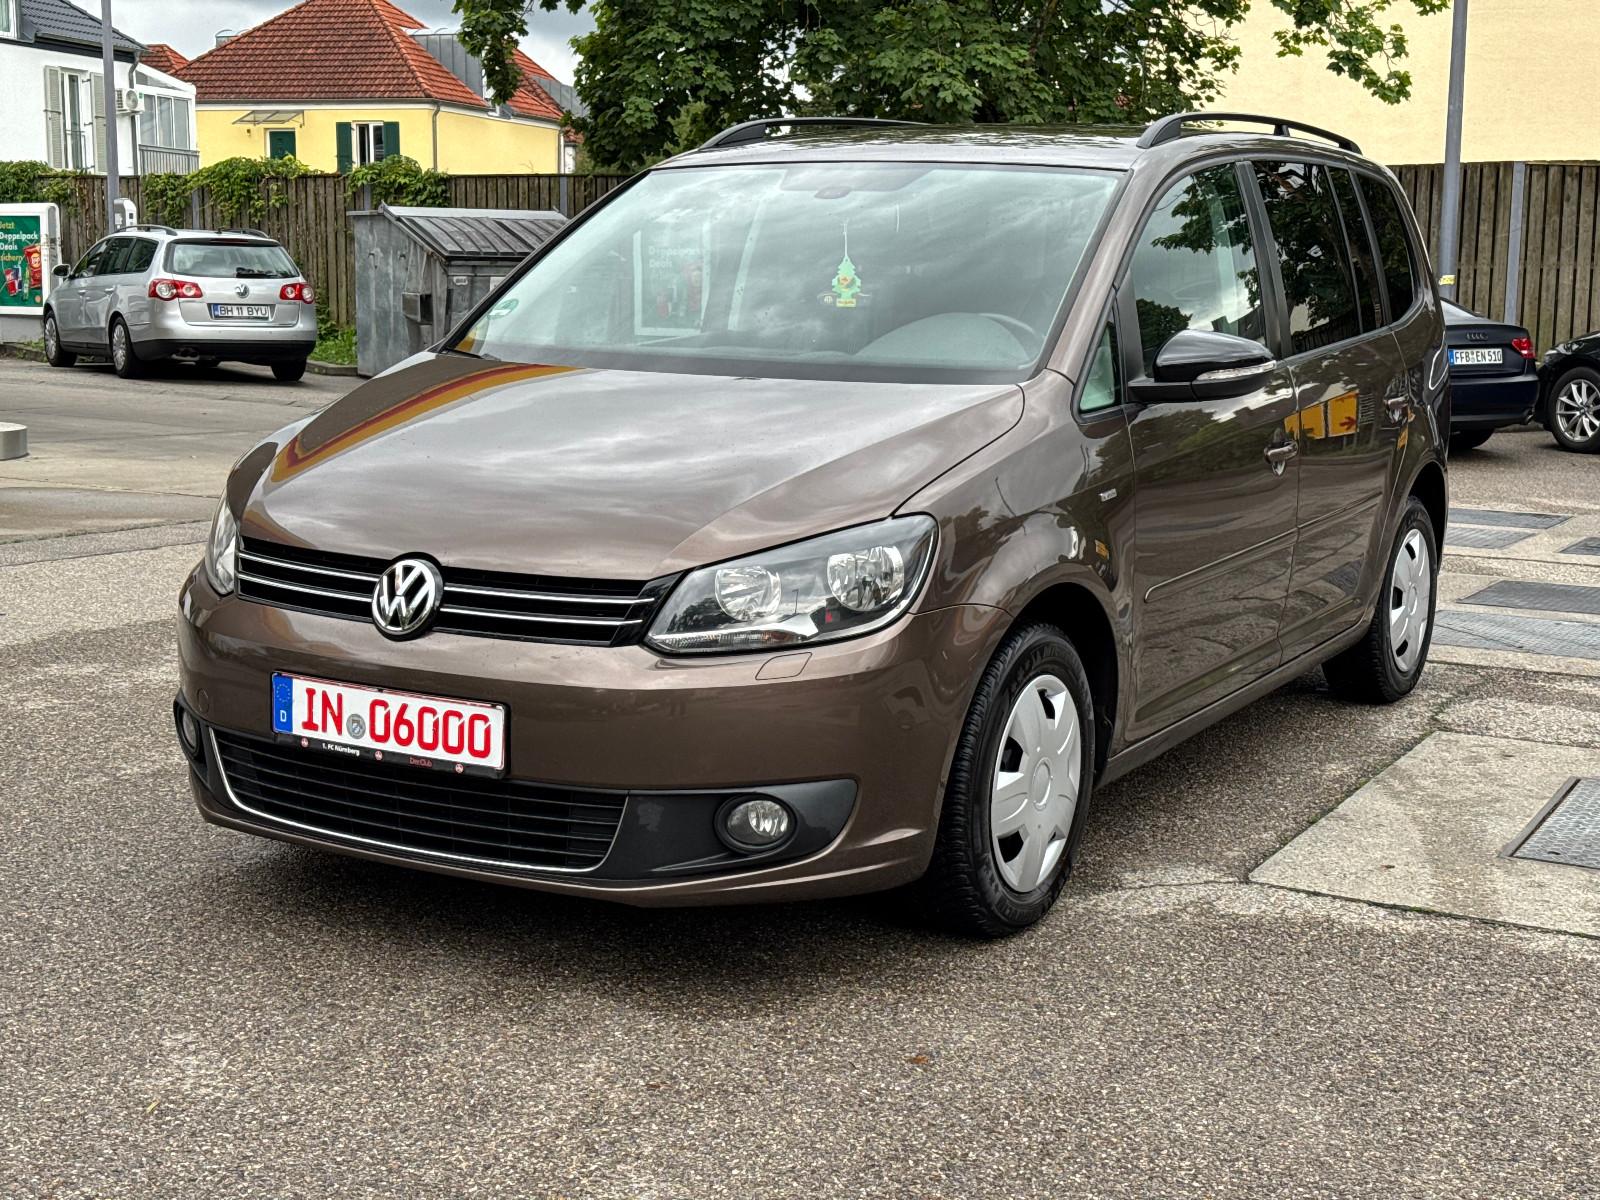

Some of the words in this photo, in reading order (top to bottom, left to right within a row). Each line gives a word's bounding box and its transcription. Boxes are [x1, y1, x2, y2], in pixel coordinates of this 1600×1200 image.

[0, 242, 18, 251] Deals
[219, 306, 234, 316] BH
[236, 306, 244, 316] 11
[246, 306, 268, 316] BYU
[1454, 351, 1471, 363] FFB
[1476, 351, 1487, 362] EN
[1488, 350, 1502, 362] 510
[280, 709, 287, 722] D
[301, 687, 343, 736] IN
[368, 698, 492, 759] 06000
[328, 743, 334, 751] FC
[335, 744, 360, 757] Nürnberg
